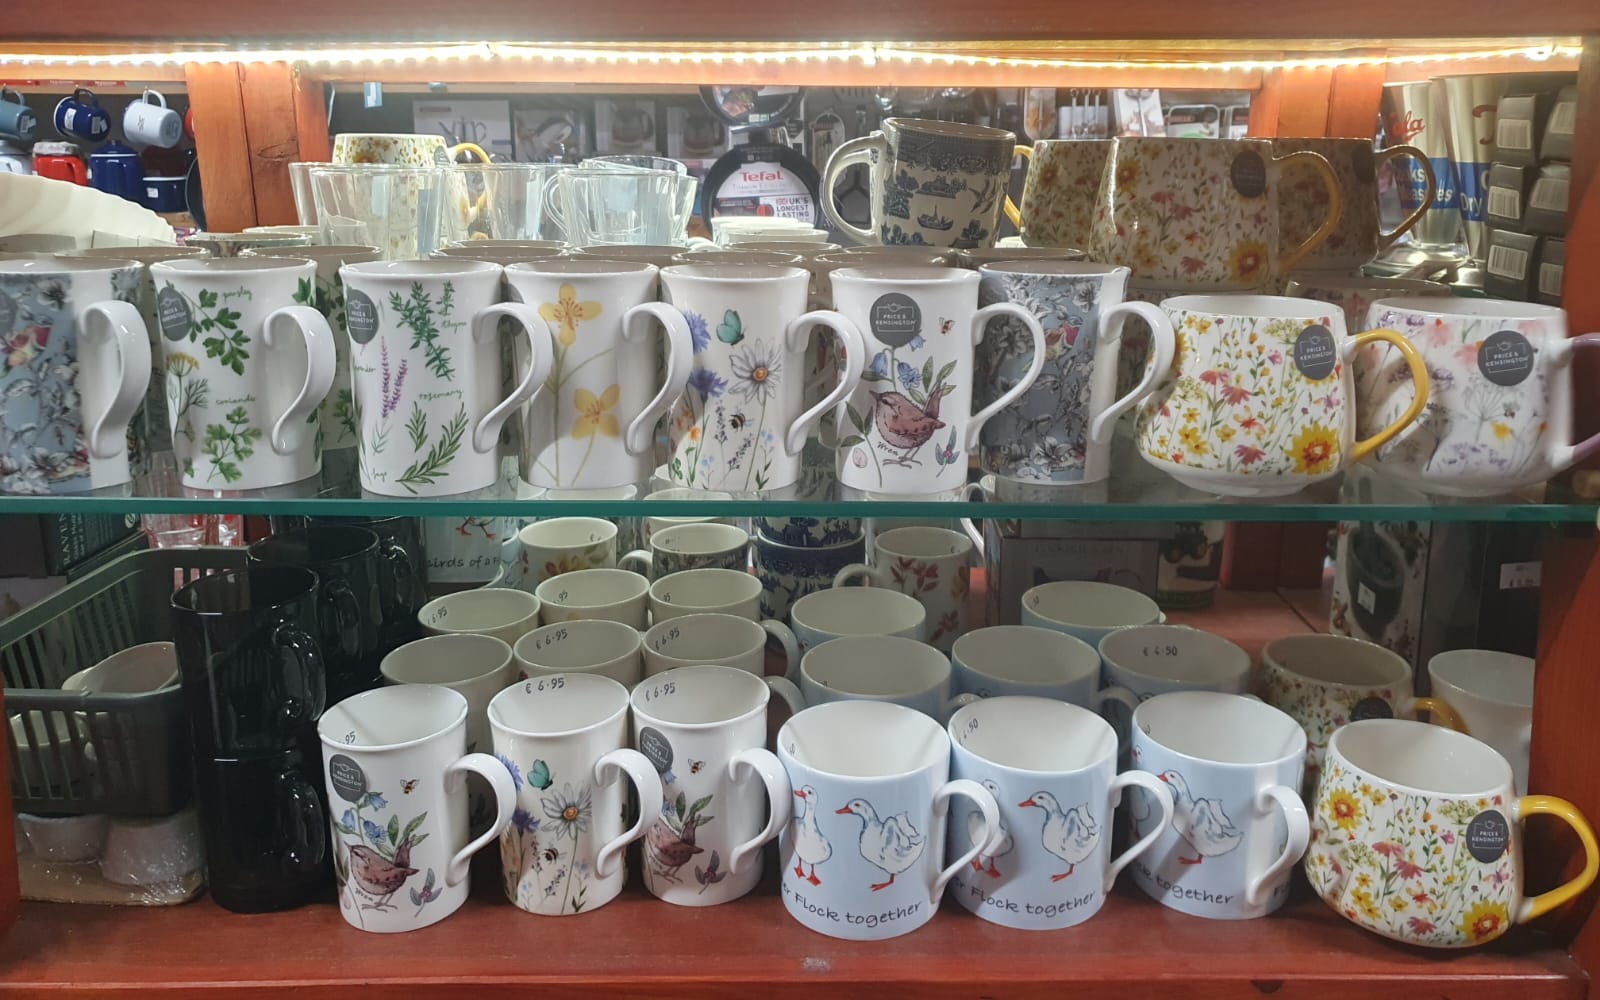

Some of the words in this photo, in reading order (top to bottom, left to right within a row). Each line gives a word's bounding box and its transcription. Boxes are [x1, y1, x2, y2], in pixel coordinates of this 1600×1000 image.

[740, 170, 784, 182] Tefal
[776, 204, 809, 212] LONGEST
[1485, 356, 1529, 367] KENSINGTON
[1494, 351, 1512, 359] PRICE
[418, 388, 464, 401] rosemary
[469, 555, 483, 569] of
[545, 628, 568, 645] 6.95
[661, 627, 680, 646] 6.95
[525, 682, 532, 694] €
[537, 677, 565, 691] 6.95
[653, 682, 676, 699] 6.95
[1156, 874, 1235, 905] together
[1025, 890, 1095, 918] together
[845, 901, 922, 929] together
